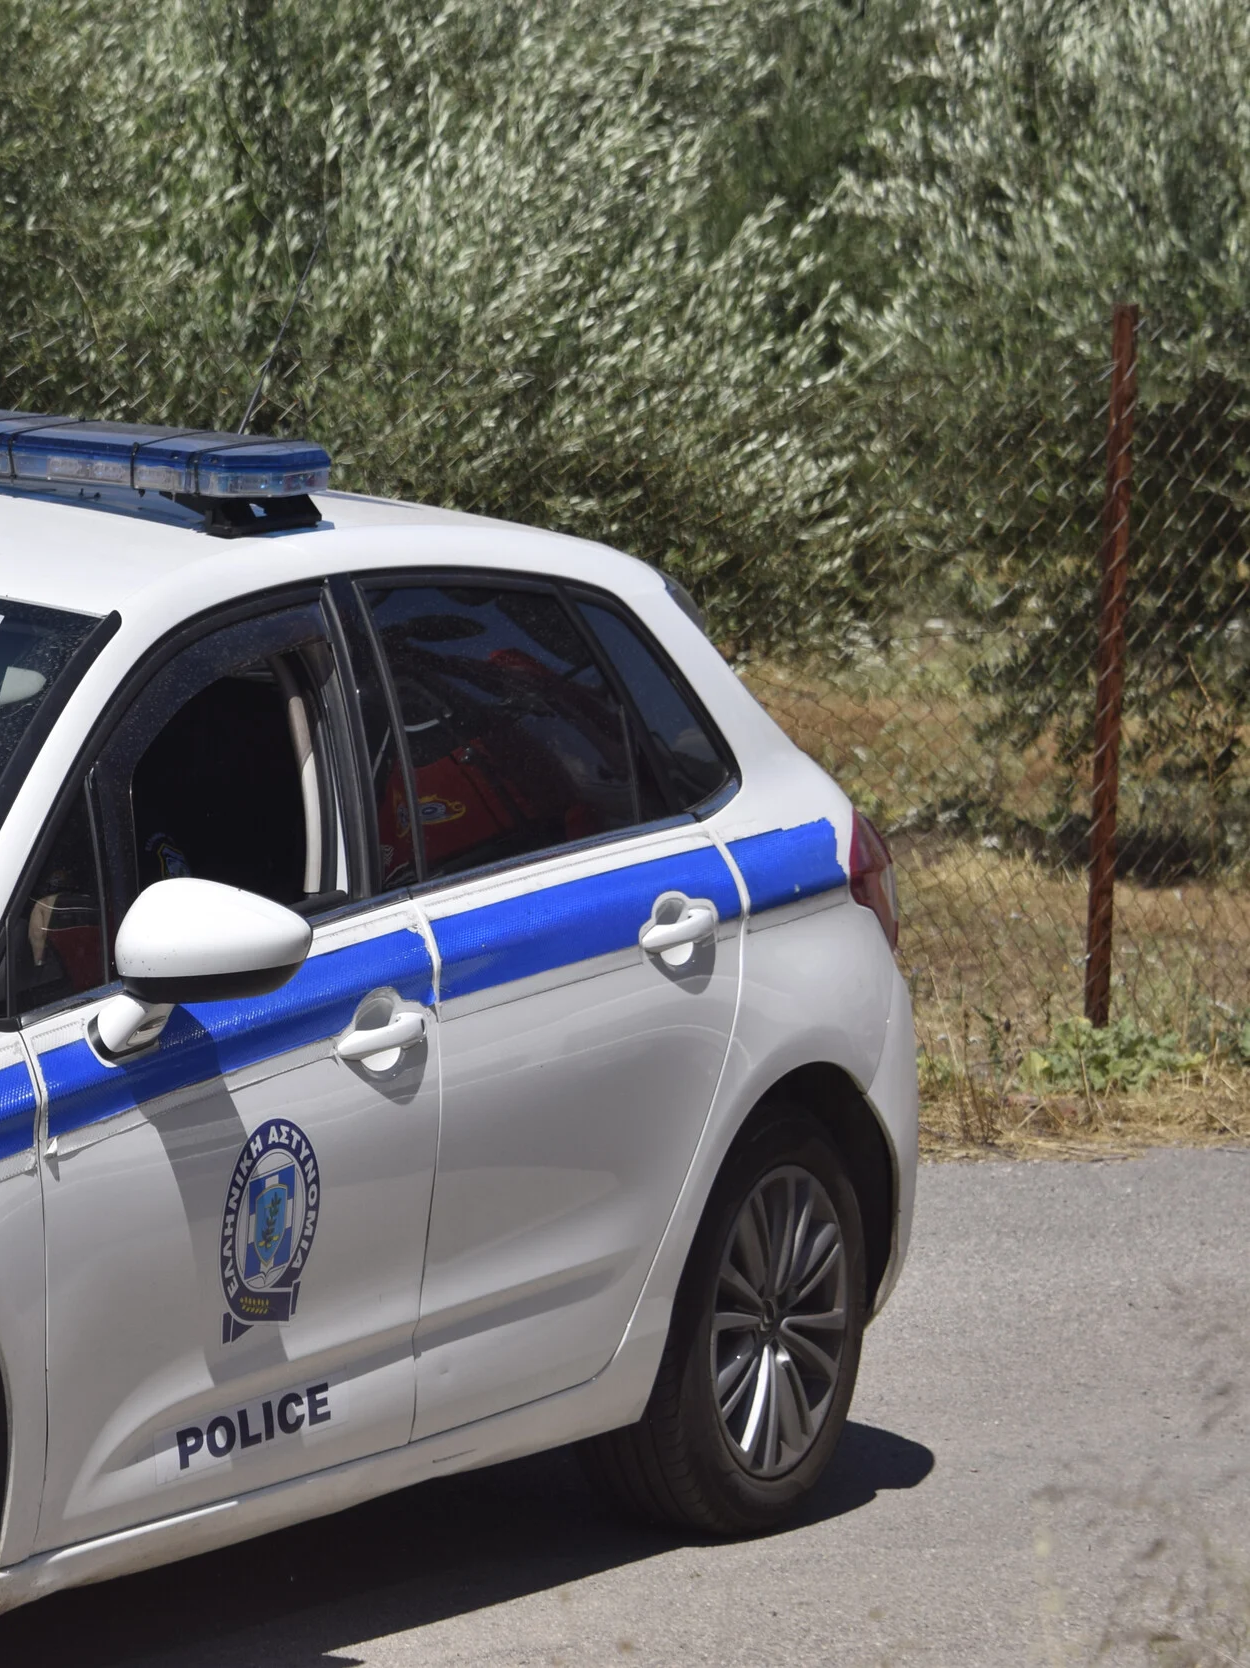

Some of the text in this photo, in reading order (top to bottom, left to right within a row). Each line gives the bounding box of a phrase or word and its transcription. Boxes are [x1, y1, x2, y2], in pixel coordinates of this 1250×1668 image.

[222, 1124, 319, 1299] ΕΛΛΗΝΙΚΗ ΑΣΤΥΝΟΜΙΑ
[176, 1382, 332, 1471] POLICE
